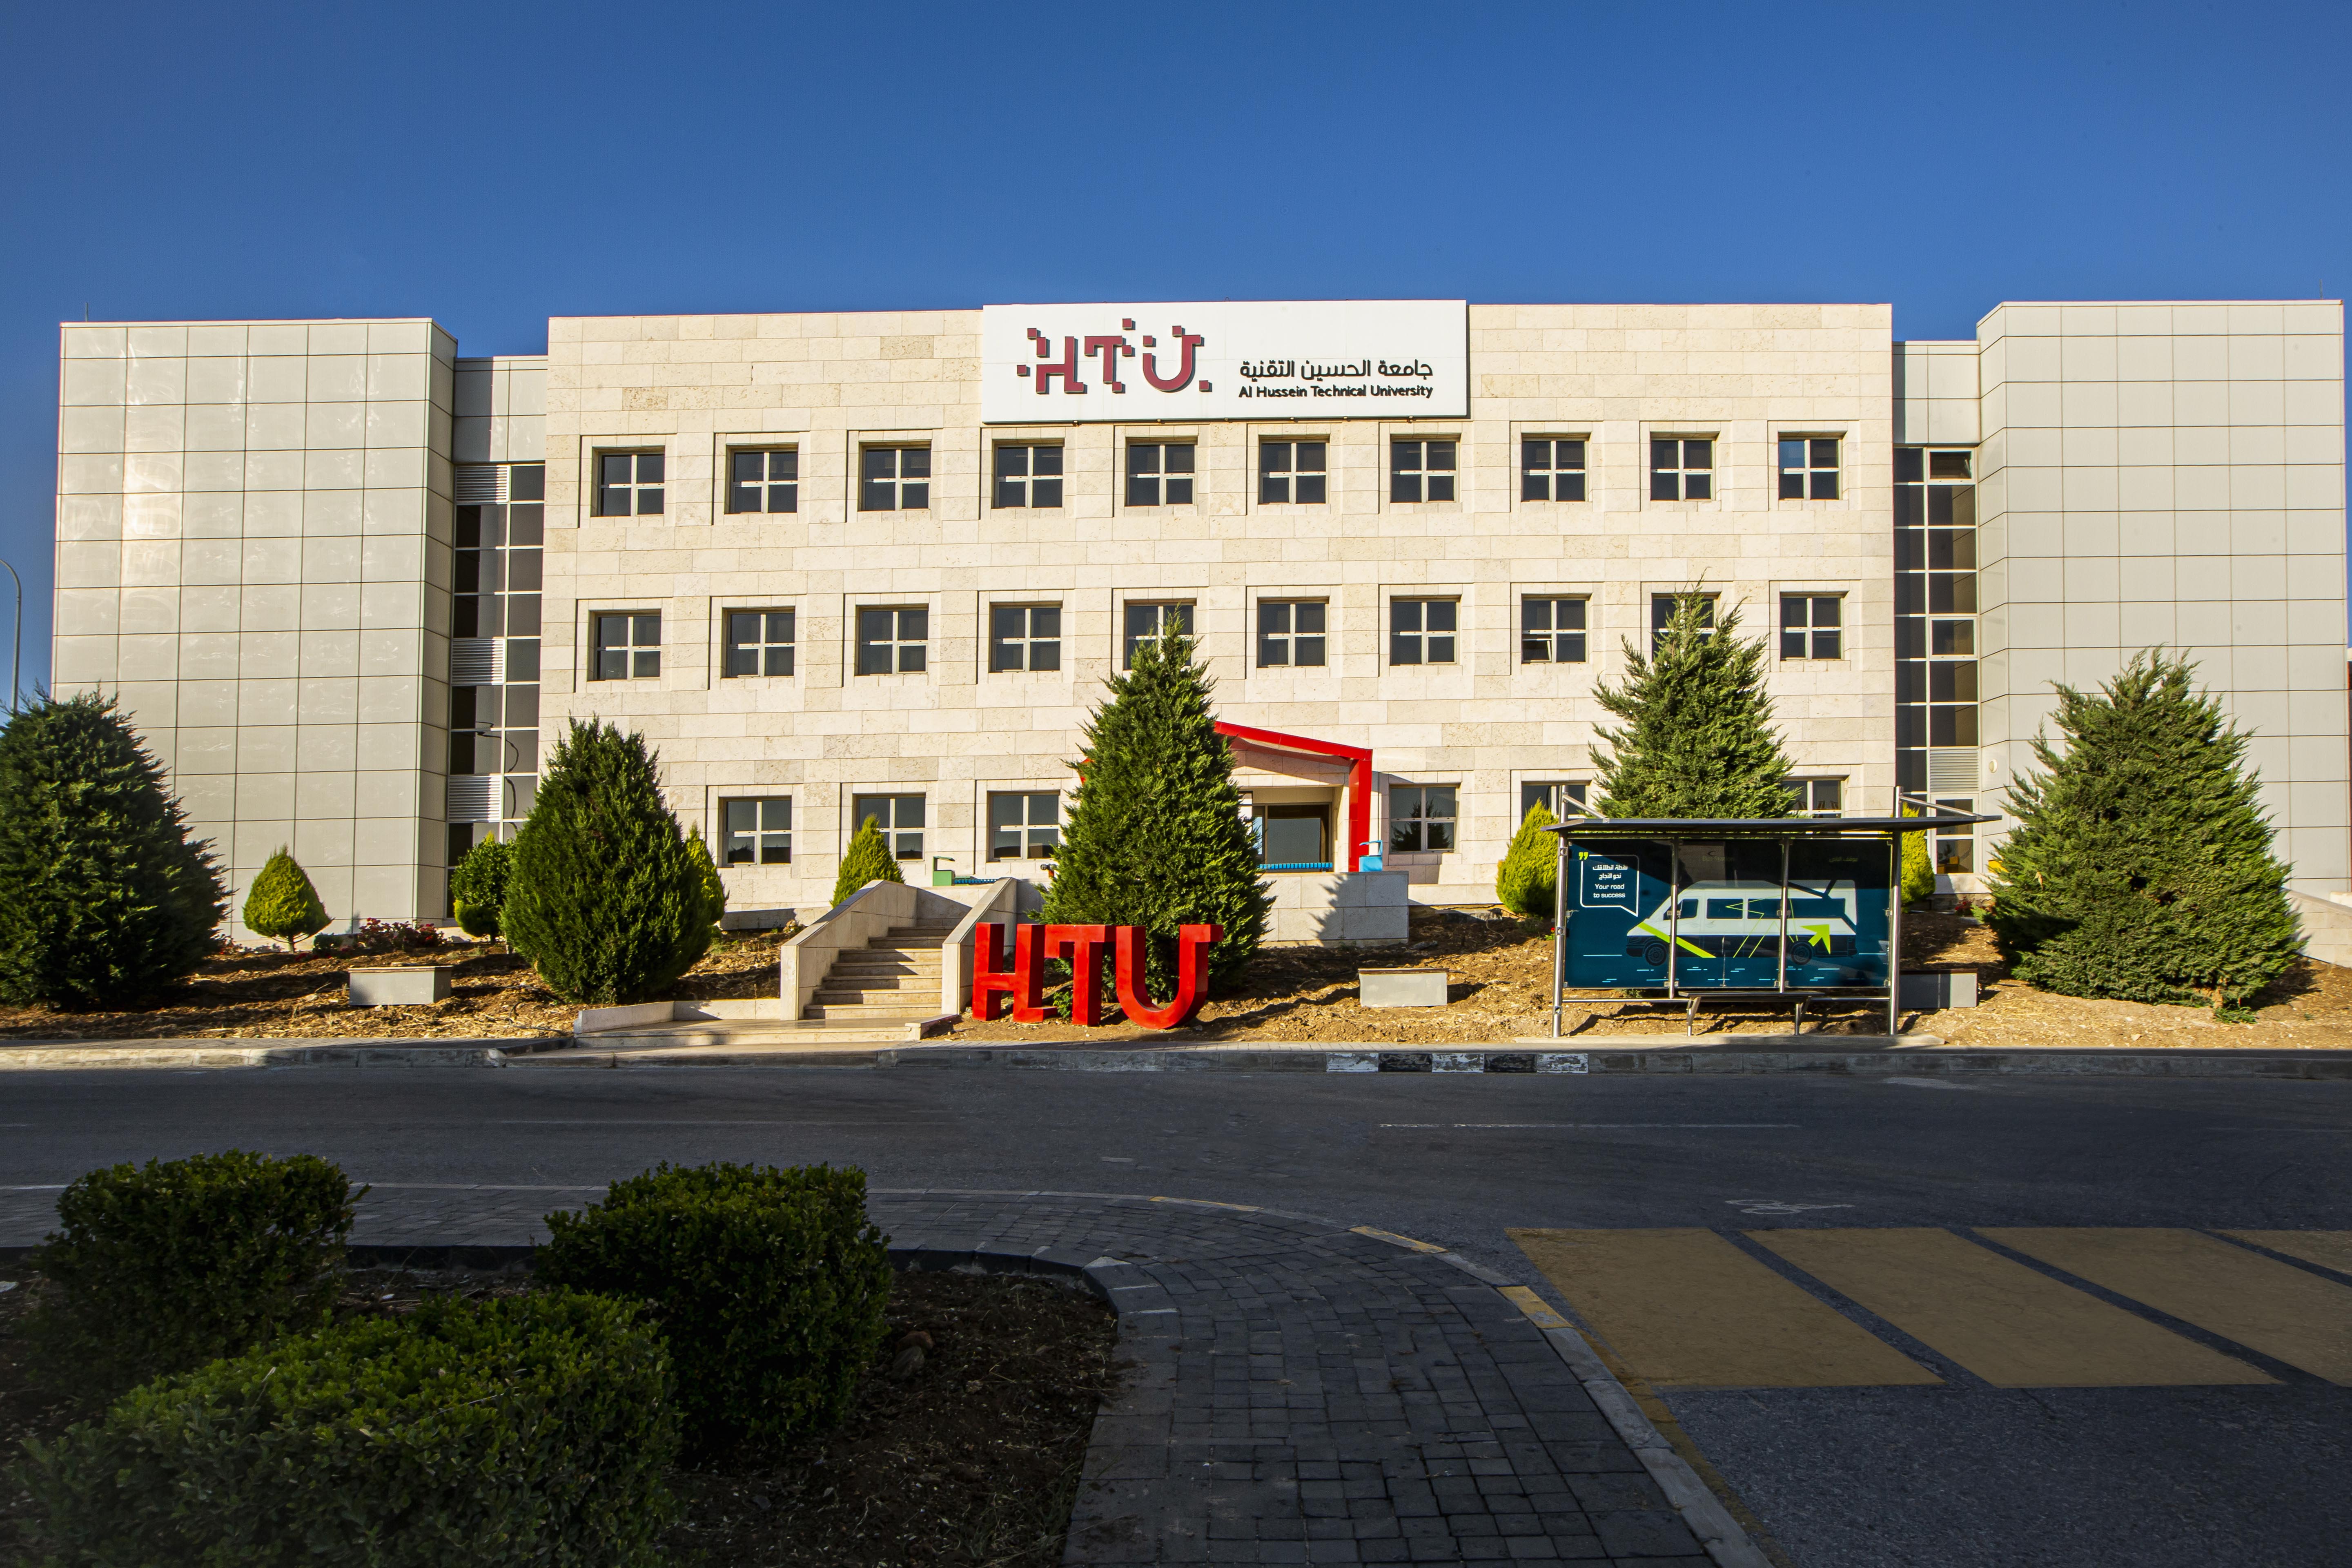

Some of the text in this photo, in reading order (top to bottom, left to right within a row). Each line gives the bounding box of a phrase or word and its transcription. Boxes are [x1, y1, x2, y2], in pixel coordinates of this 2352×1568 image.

[1240, 359, 1433, 382] جامعة الحسين التقنية
[1238, 384, 1433, 399] Al Hussein Technical University
[972, 922, 1224, 1029] HTU
